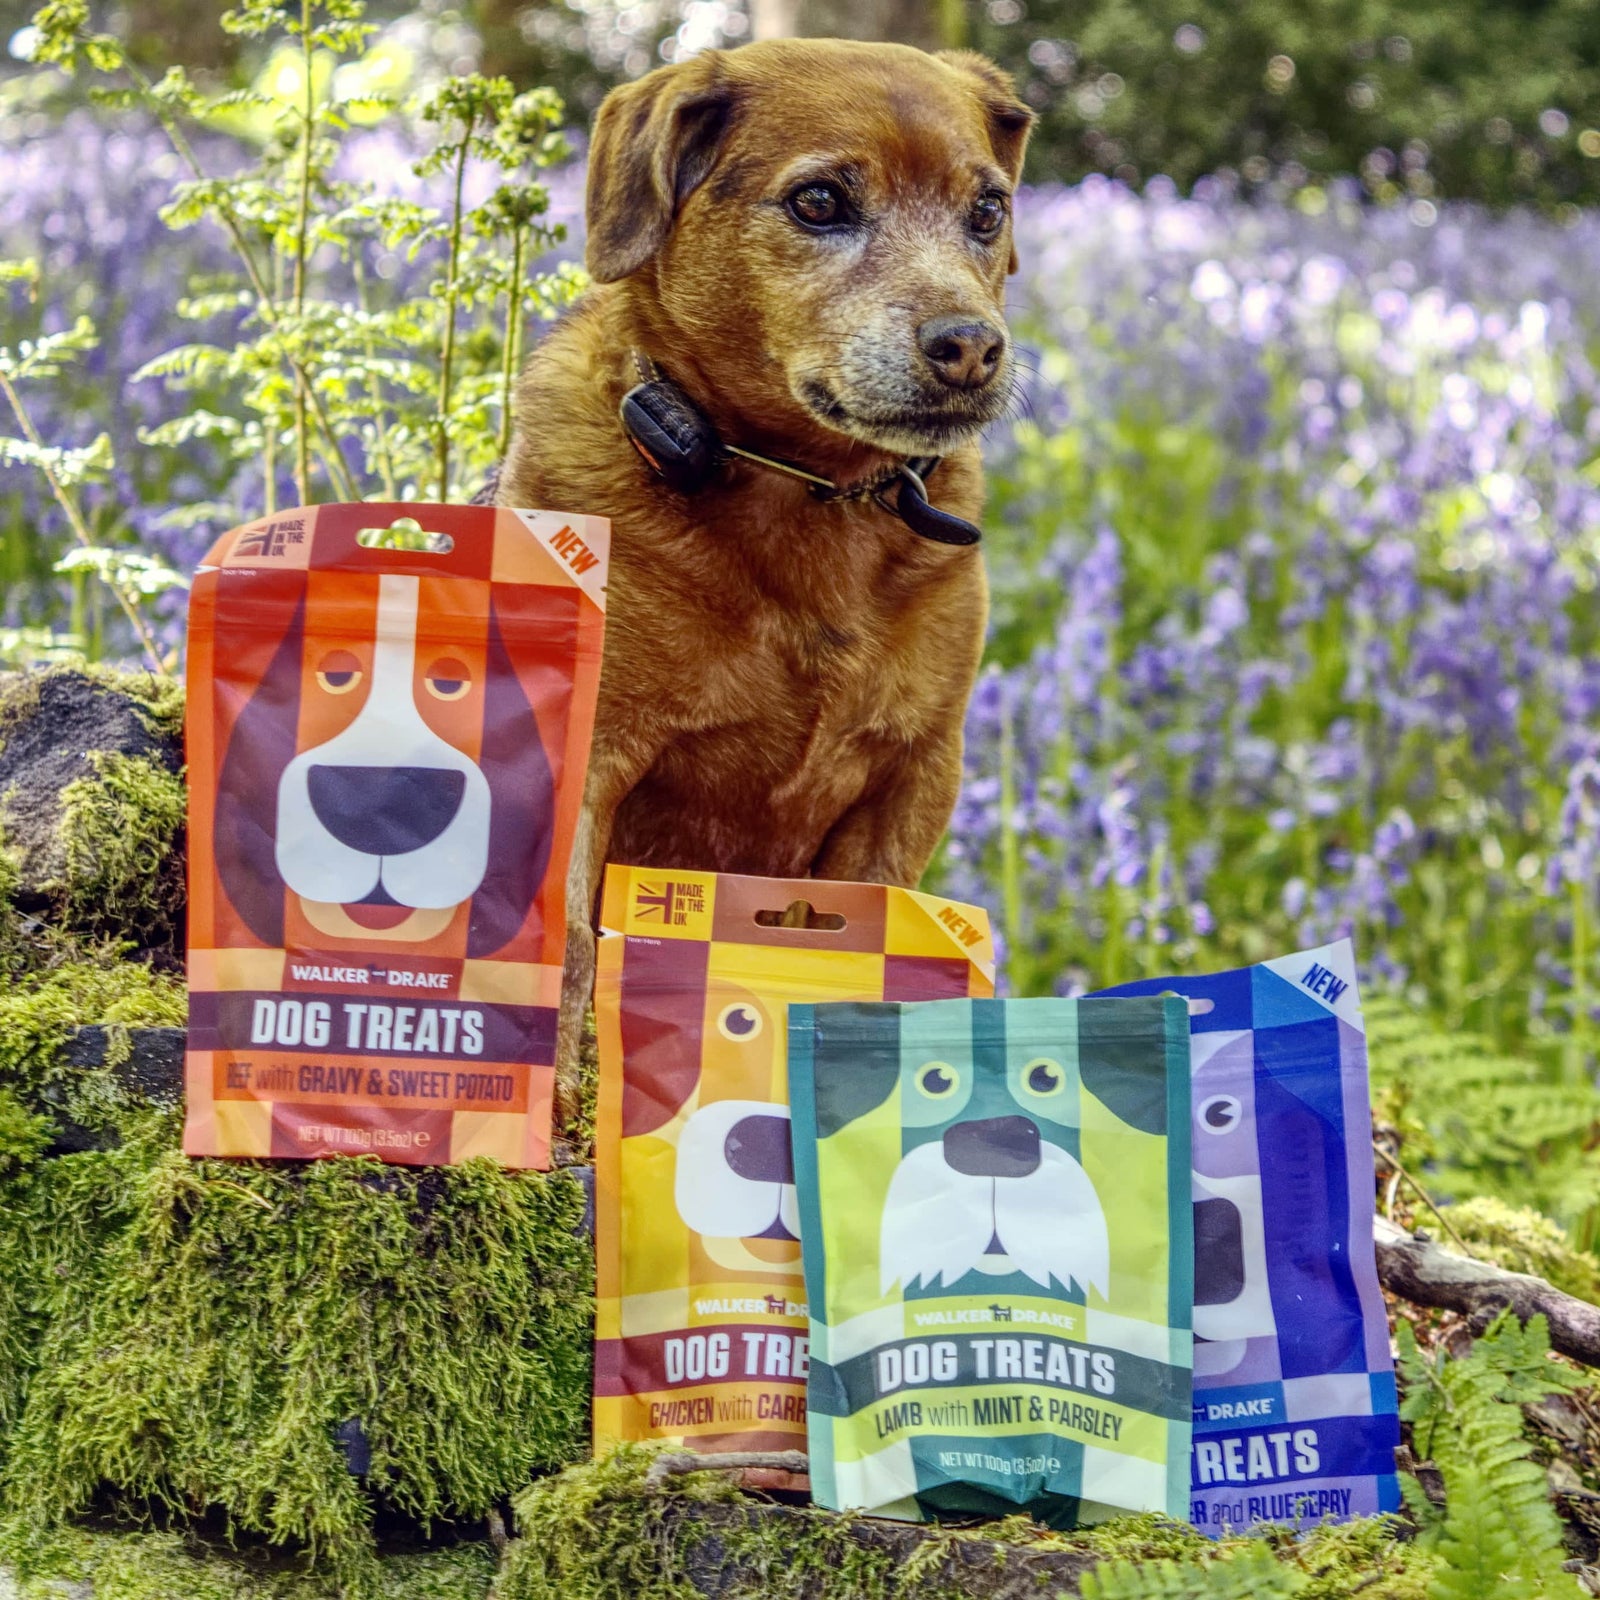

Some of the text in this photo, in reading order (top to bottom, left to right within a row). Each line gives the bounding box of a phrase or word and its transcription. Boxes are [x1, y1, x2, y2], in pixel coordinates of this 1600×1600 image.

[277, 520, 305, 531] MADE
[274, 532, 305, 544] IN THE
[272, 545, 286, 557] UK
[549, 525, 600, 576] NEW
[676, 883, 704, 898] MADE
[675, 898, 705, 912] IN THE
[674, 912, 688, 926] UK
[937, 906, 984, 949] NEW
[292, 965, 449, 989] WALKER DRAKE
[1300, 962, 1349, 1005] NEW
[251, 999, 484, 1056] DOG TREATS
[256, 1063, 295, 1091] with
[299, 1064, 363, 1095] GRAVY
[367, 1068, 382, 1096] &
[388, 1069, 451, 1098] SWEET
[455, 1073, 514, 1101] POTATO
[298, 1125, 321, 1143] NET
[323, 1126, 341, 1144] WT
[695, 1297, 809, 1317] WALKER DR
[914, 1309, 1075, 1330] WALKER DRAKE
[664, 1332, 809, 1383] DOG TRE
[878, 1338, 1115, 1395] DOG TREATS
[650, 1393, 807, 1429] CHICKEN with CARR
[875, 1395, 1124, 1442] LAMB with MINT & PARSLEY
[1208, 1398, 1272, 1420] DRAKE
[939, 1452, 961, 1467] NET
[963, 1453, 982, 1467] WT
[985, 1455, 1011, 1475] 100g
[1190, 1429, 1321, 1485] REATS
[1212, 1499, 1243, 1524] and
